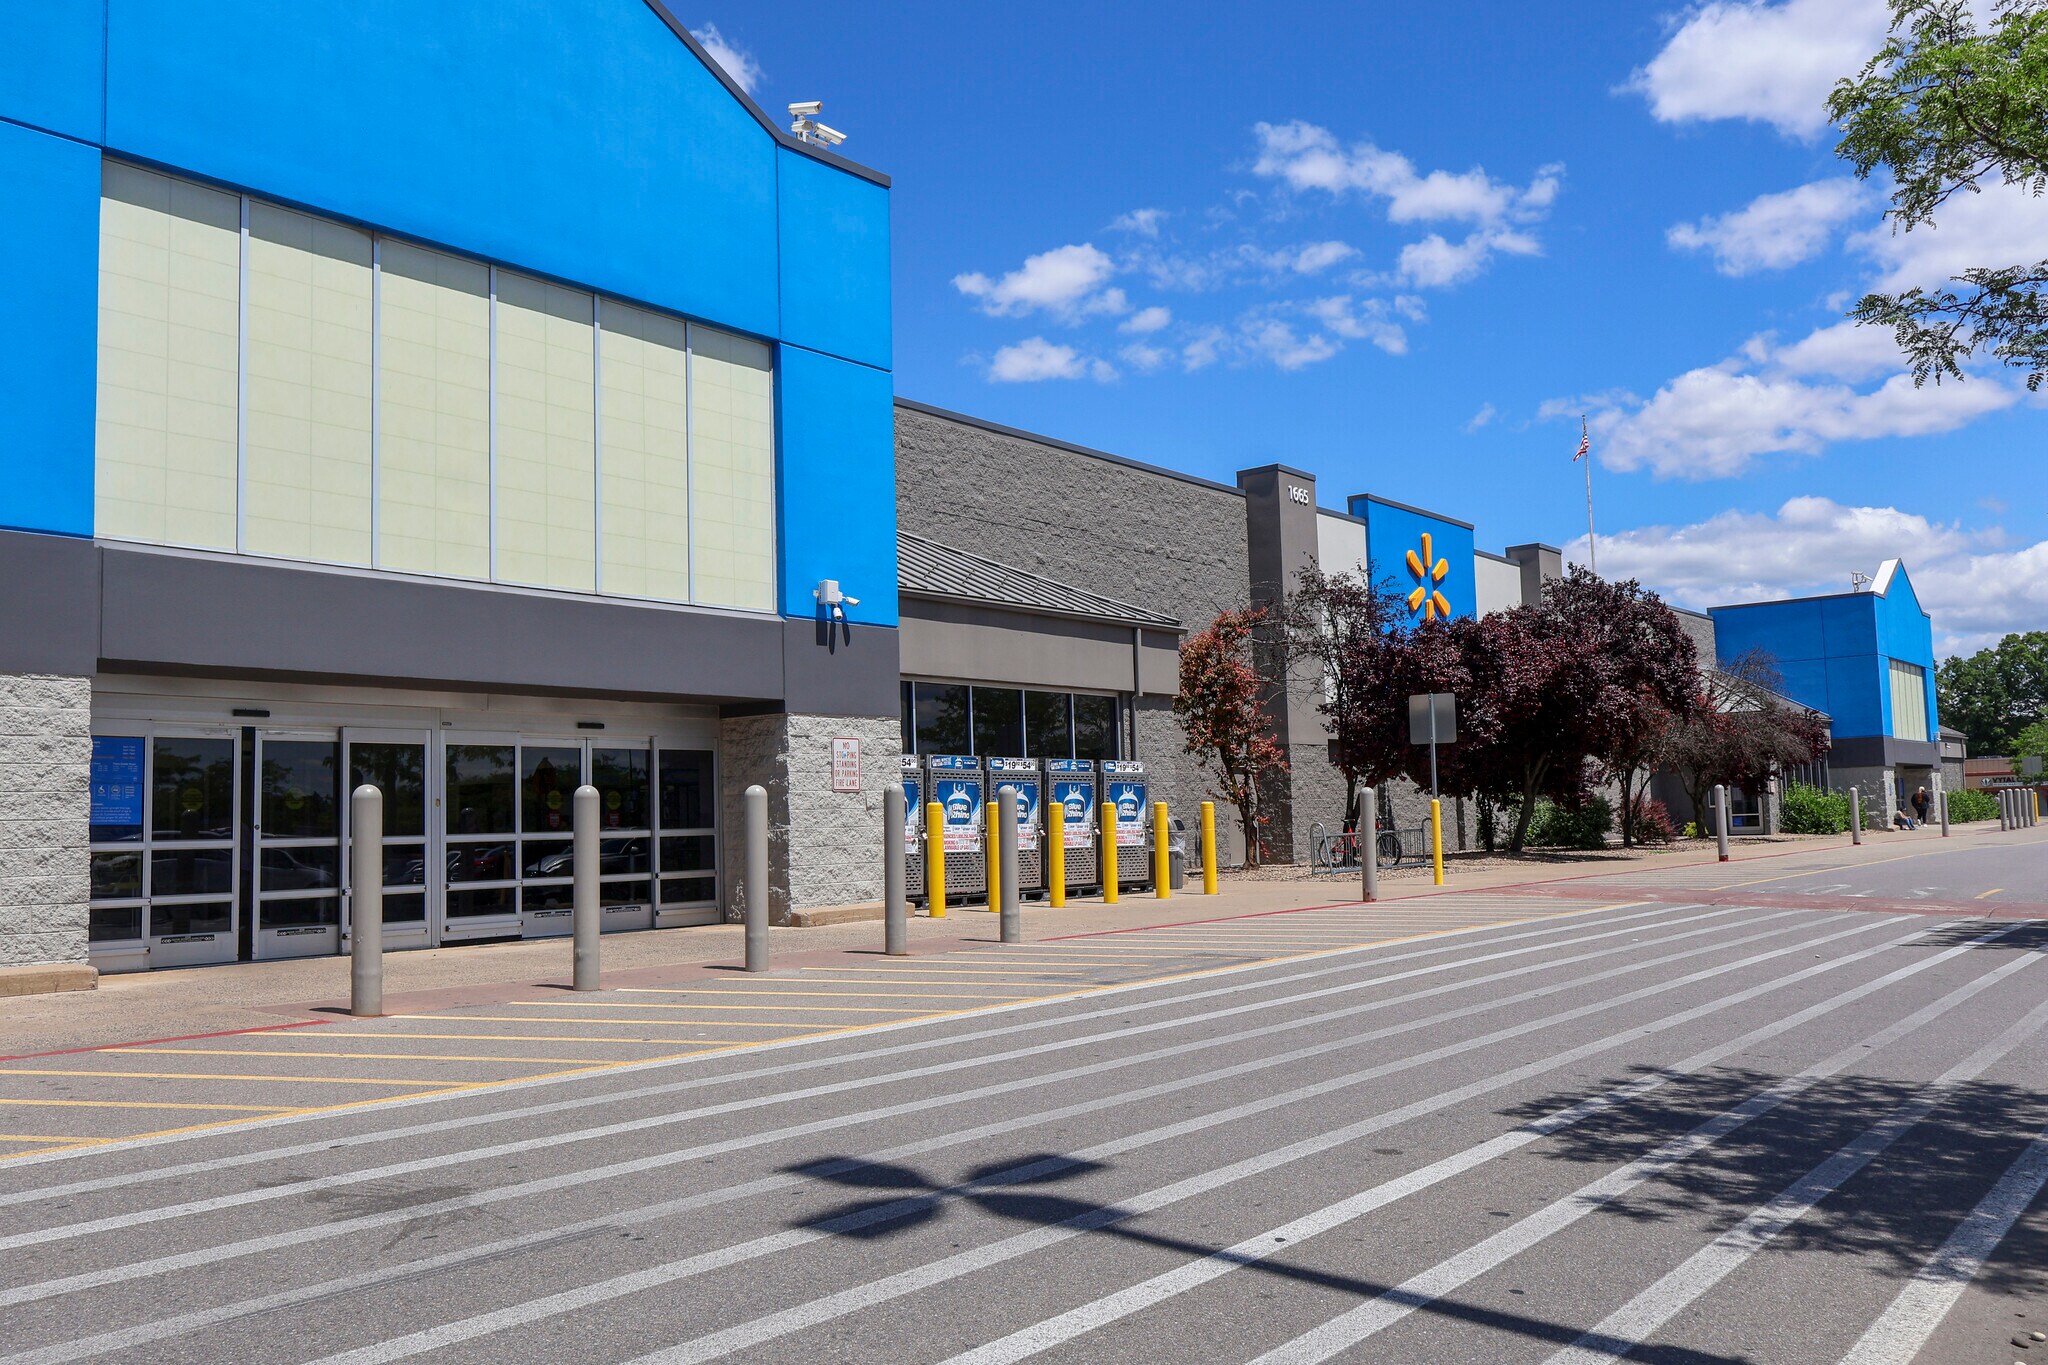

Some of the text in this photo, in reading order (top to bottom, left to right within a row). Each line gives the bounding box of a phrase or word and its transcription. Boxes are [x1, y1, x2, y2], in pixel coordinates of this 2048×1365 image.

[1288, 485, 1309, 504] 1665
[843, 742, 850, 750] NO
[836, 751, 857, 759] STOPING
[836, 760, 857, 768] STANDING
[835, 769, 858, 777] OR PARKING
[952, 803, 968, 811] Blue
[951, 810, 970, 819] Rhino
